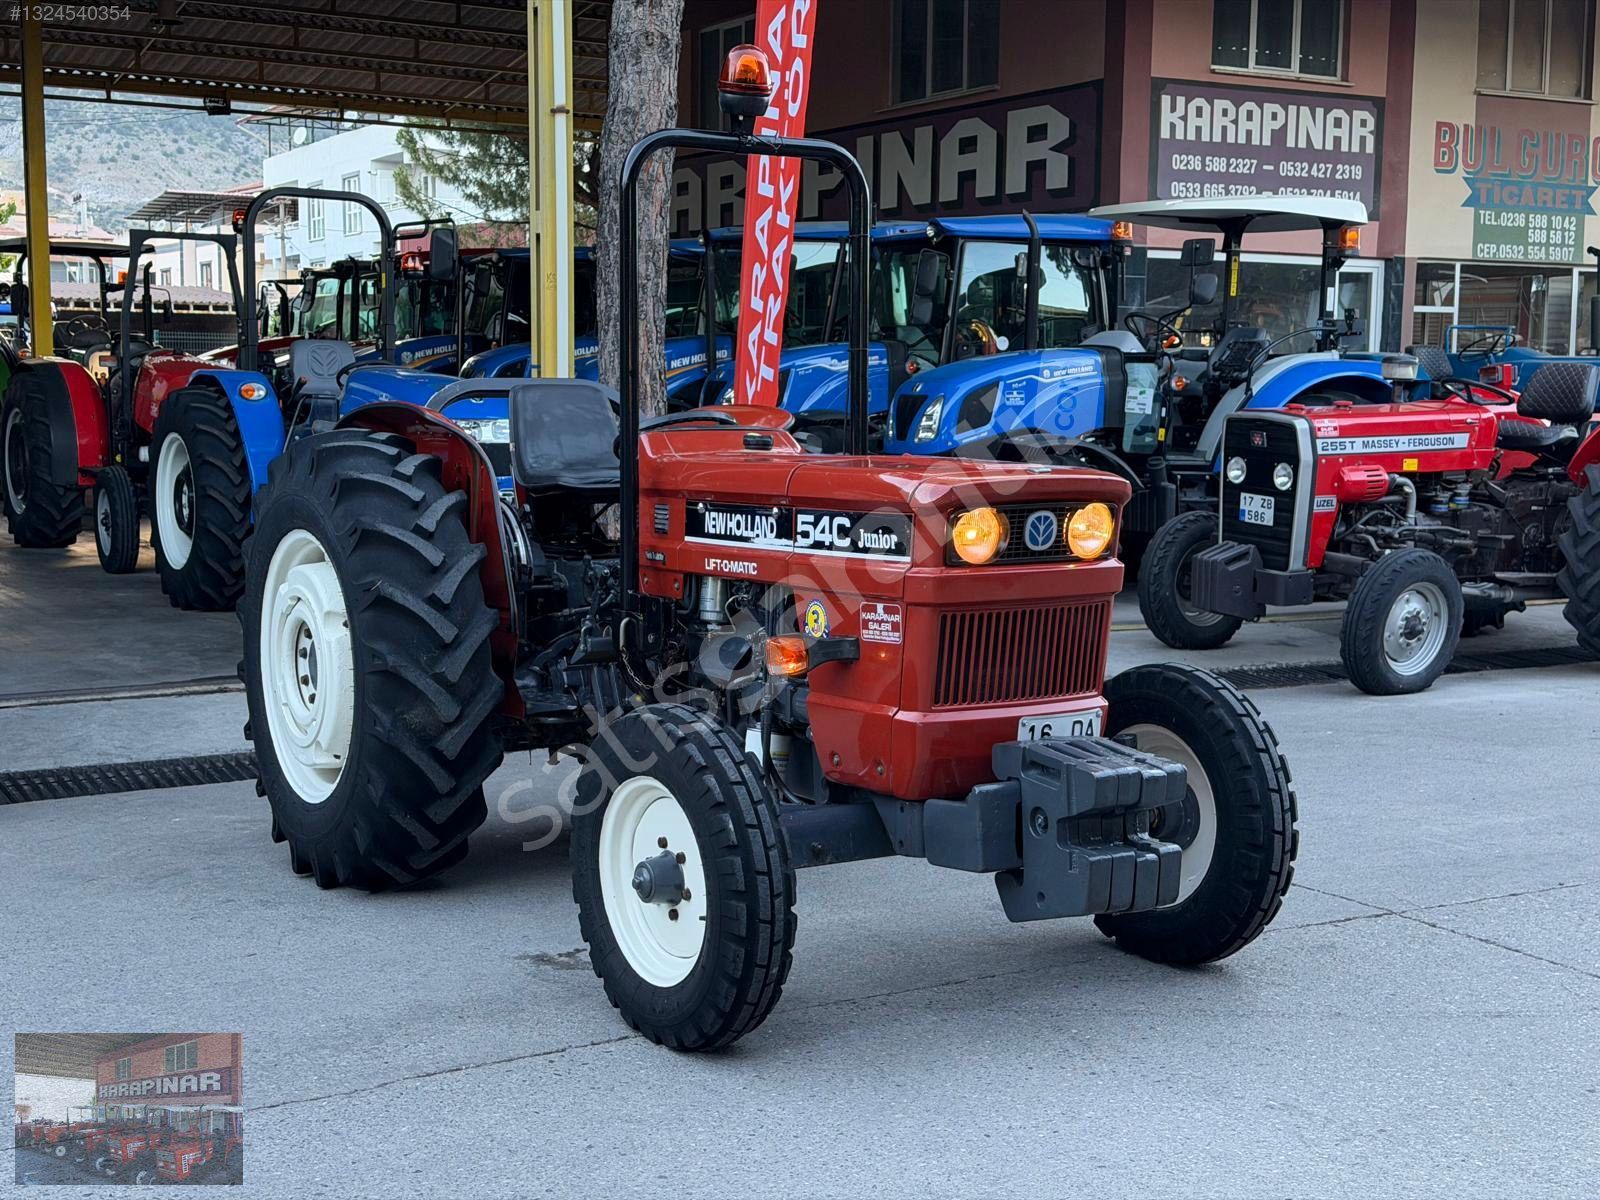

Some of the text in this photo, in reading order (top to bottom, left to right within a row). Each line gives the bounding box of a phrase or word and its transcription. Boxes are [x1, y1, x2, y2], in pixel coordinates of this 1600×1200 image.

[1160, 94, 1375, 154] KARAPINAR
[1172, 154, 1202, 171] 0236
[1205, 156, 1227, 172] 588
[1228, 158, 1258, 174] 2327
[1279, 161, 1309, 178] 0532
[1310, 164, 1332, 179] 427
[1335, 164, 1363, 180] 2319
[1171, 181, 1201, 198] 0533
[1203, 183, 1226, 198] 665
[1528, 213, 1548, 229] 588
[1528, 229, 1547, 243] 588
[1527, 246, 1546, 260] 554
[670, 349, 728, 369] NEW HOLND
[1362, 439, 1400, 449] MASSEY
[1407, 437, 1455, 447] FERGUSON
[1260, 497, 1273, 510] ZB
[1247, 510, 1266, 523] 586
[705, 511, 898, 550] NEW HOLLAND 54C Junior
[861, 612, 900, 622] KARAPINAR
